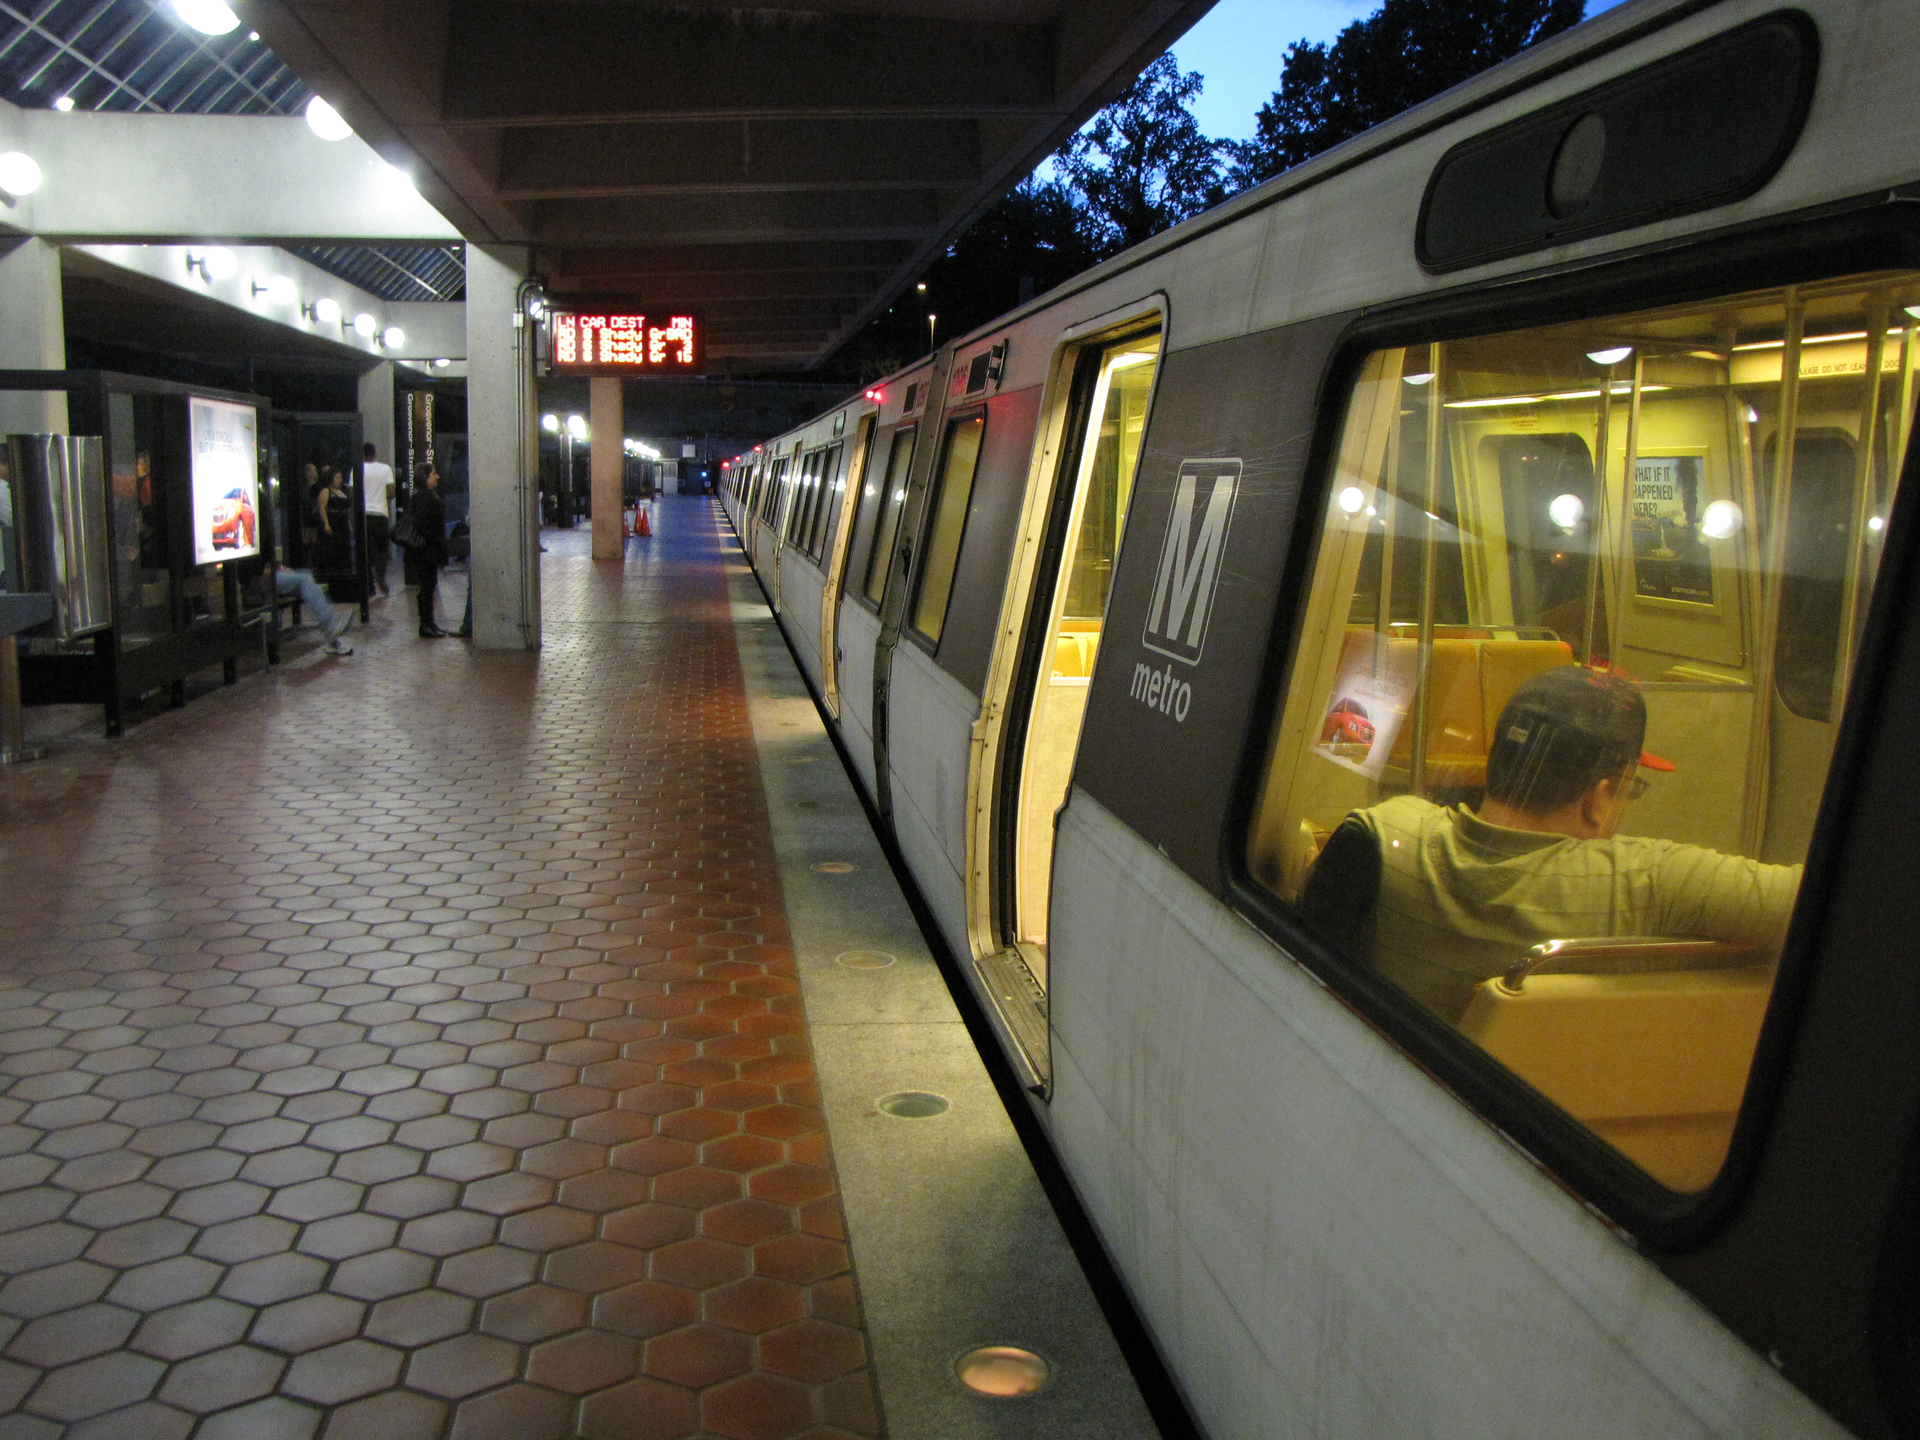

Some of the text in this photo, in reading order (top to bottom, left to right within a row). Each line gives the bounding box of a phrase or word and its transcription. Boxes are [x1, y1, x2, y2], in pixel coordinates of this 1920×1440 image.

[557, 316, 693, 328] LN CAR DEST MIN
[557, 328, 576, 340] RD
[600, 328, 643, 341] Shady
[649, 328, 667, 340] Gr
[666, 328, 693, 340] BRD
[557, 339, 576, 351] RD
[600, 339, 643, 352] Shady
[649, 339, 667, 351] Gr
[683, 340, 693, 351] 3
[557, 350, 576, 362] RD
[600, 350, 643, 364] Shady
[649, 350, 667, 362] Gr
[676, 350, 693, 362] 15
[1822, 365, 1832, 374] DO
[1834, 363, 1847, 372] NOT
[1654, 466, 1661, 482] IF
[1664, 466, 1670, 482] IT
[1148, 475, 1235, 648] M
[1130, 662, 1191, 722] metro
